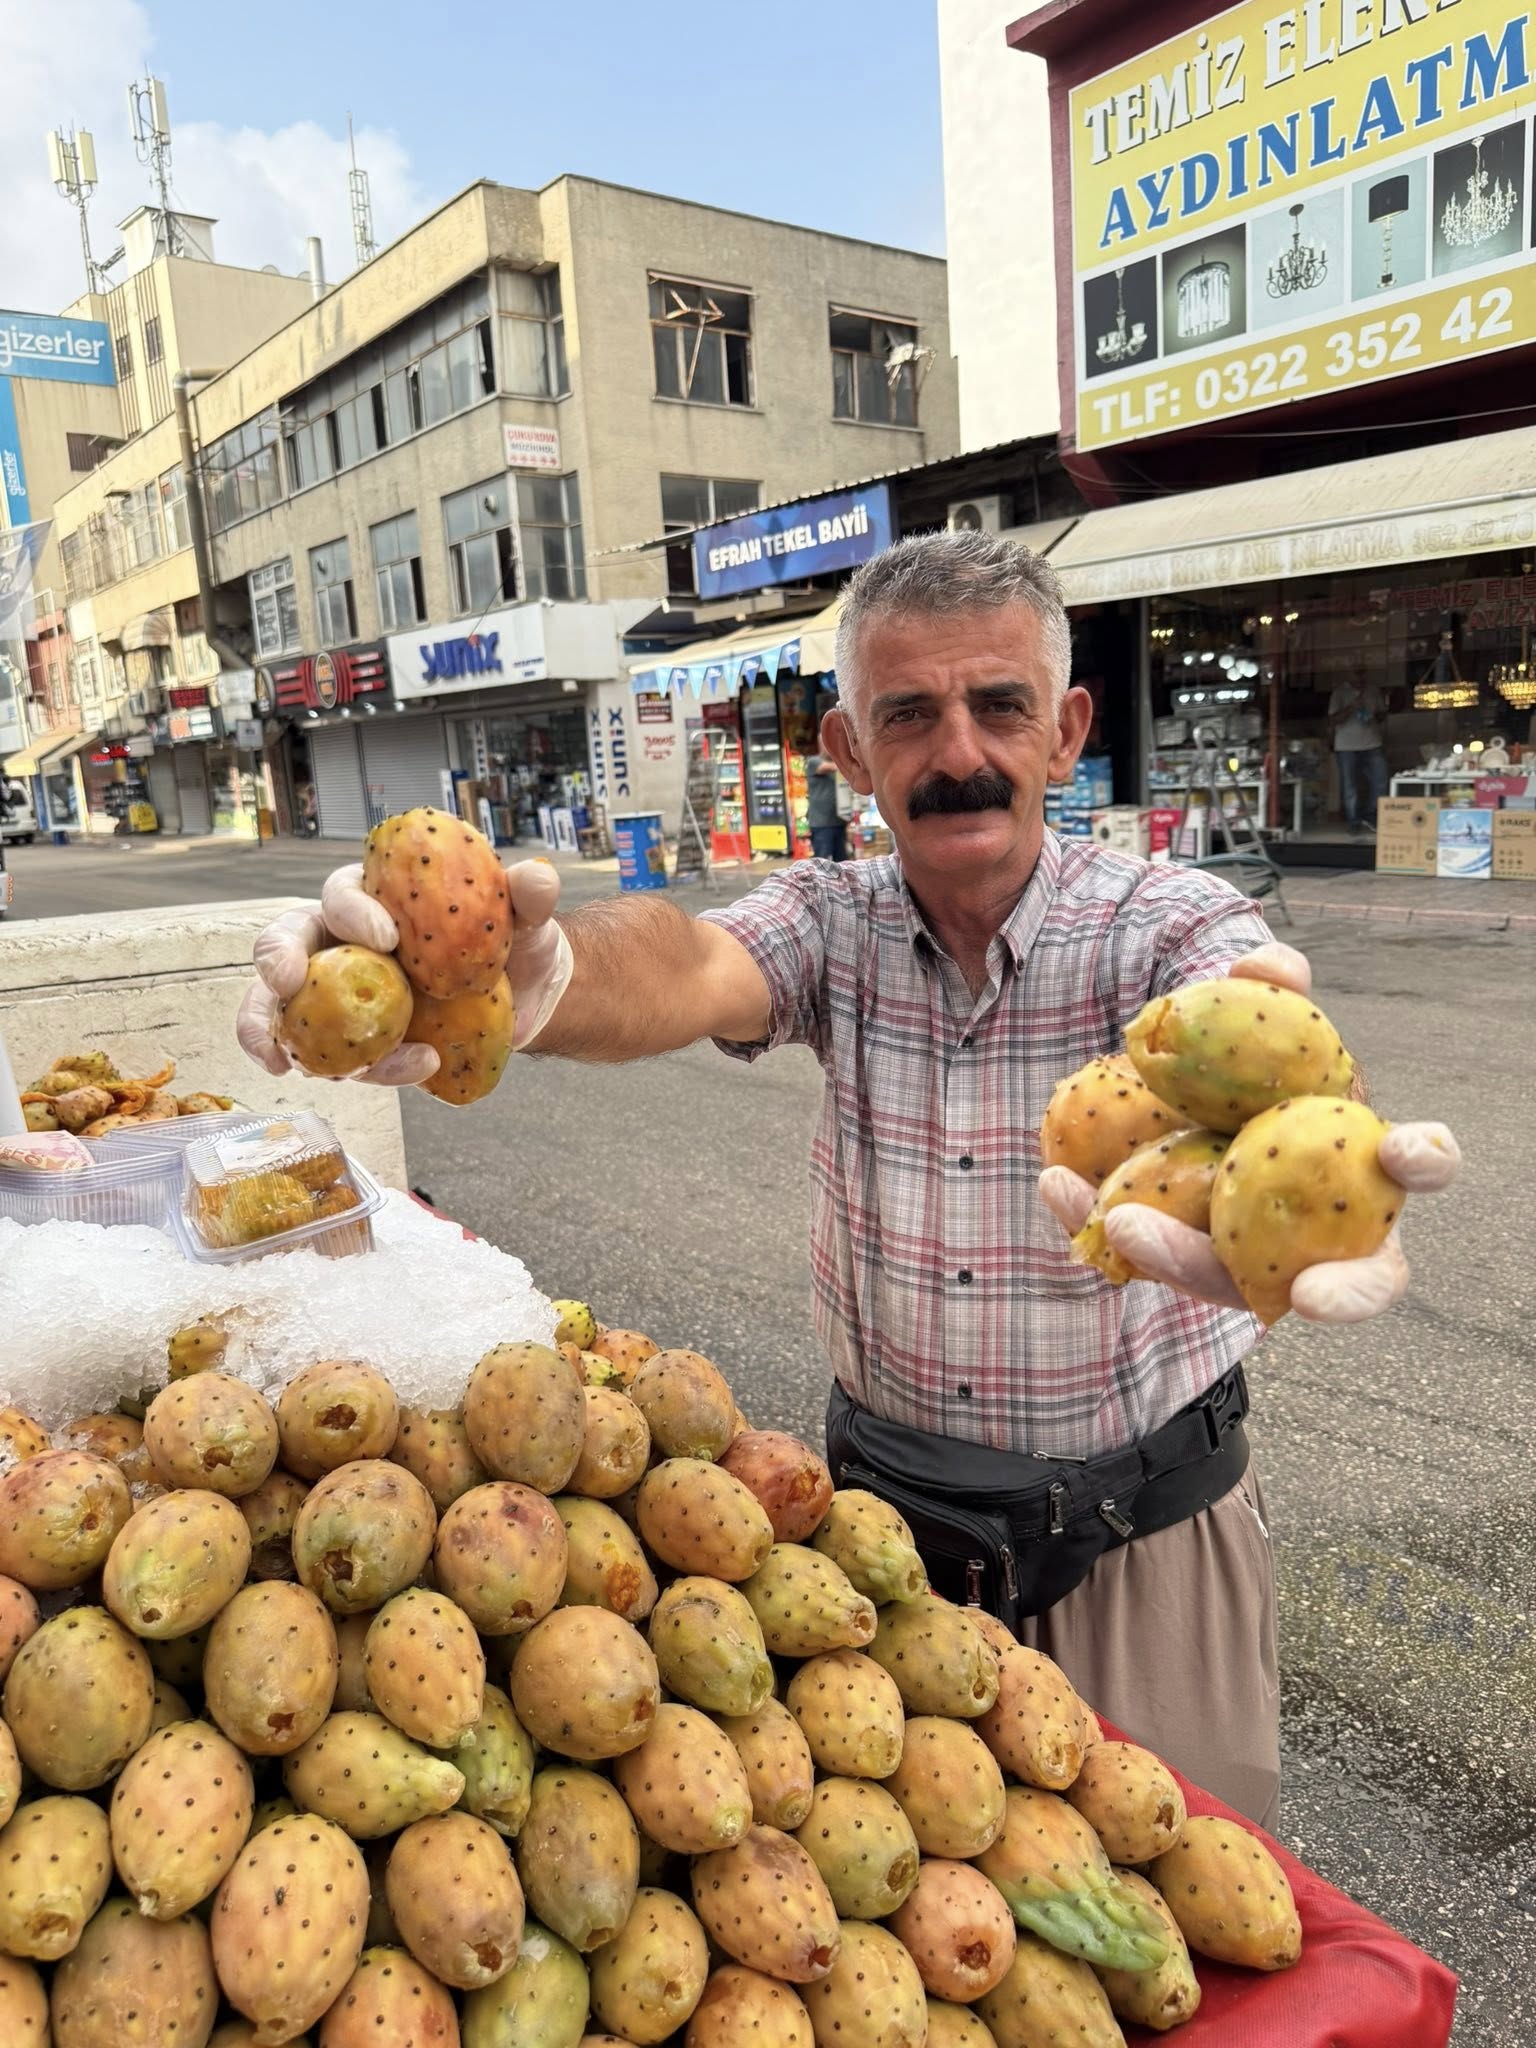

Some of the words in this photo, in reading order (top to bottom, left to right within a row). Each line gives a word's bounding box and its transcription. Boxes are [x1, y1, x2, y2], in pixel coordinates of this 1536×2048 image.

[1084, 33, 1245, 164] TEMİZ
[1263, 0, 1463, 88] ELEK
[0, 325, 105, 368] gizerler
[1093, 381, 1181, 433] TLF:
[1196, 345, 1308, 410] 0322
[1325, 312, 1422, 377] 352
[1441, 287, 1513, 344] 42
[3, 449, 26, 496] gizerler
[709, 537, 762, 572] EFRAH
[763, 524, 817, 558] TEKEL
[818, 503, 868, 544] BAYİİ
[609, 707, 630, 797] sunix
